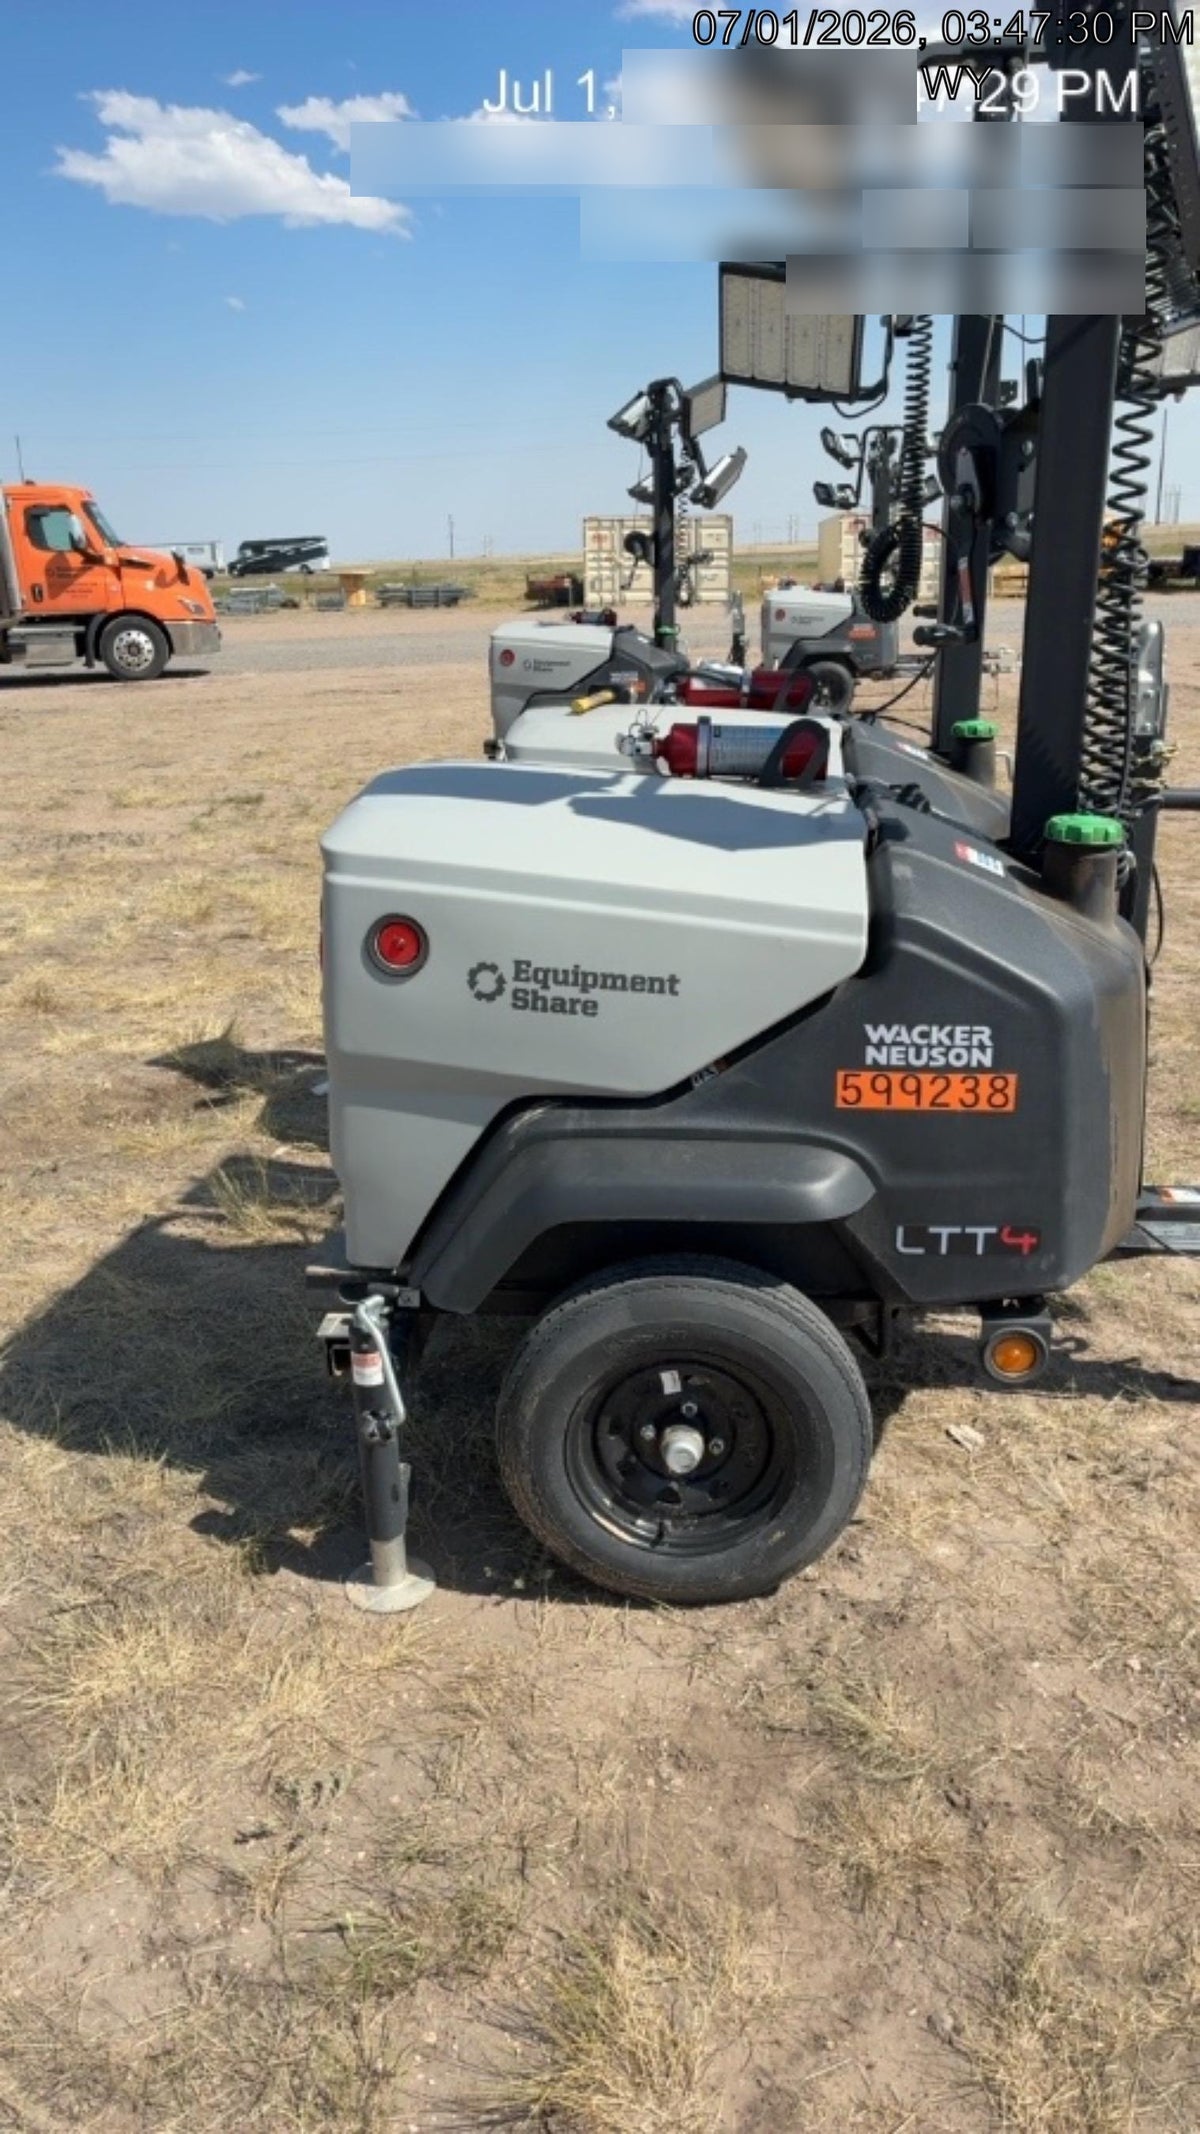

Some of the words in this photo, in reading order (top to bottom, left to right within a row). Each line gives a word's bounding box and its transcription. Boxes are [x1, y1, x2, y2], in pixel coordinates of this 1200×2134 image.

[511, 959, 681, 997] Equipment
[511, 987, 599, 1018] Share
[863, 1023, 994, 1047] WACKER
[864, 1045, 993, 1068] NEUSON
[839, 1073, 1010, 1109] 599238
[896, 1225, 1038, 1256] LTT4
